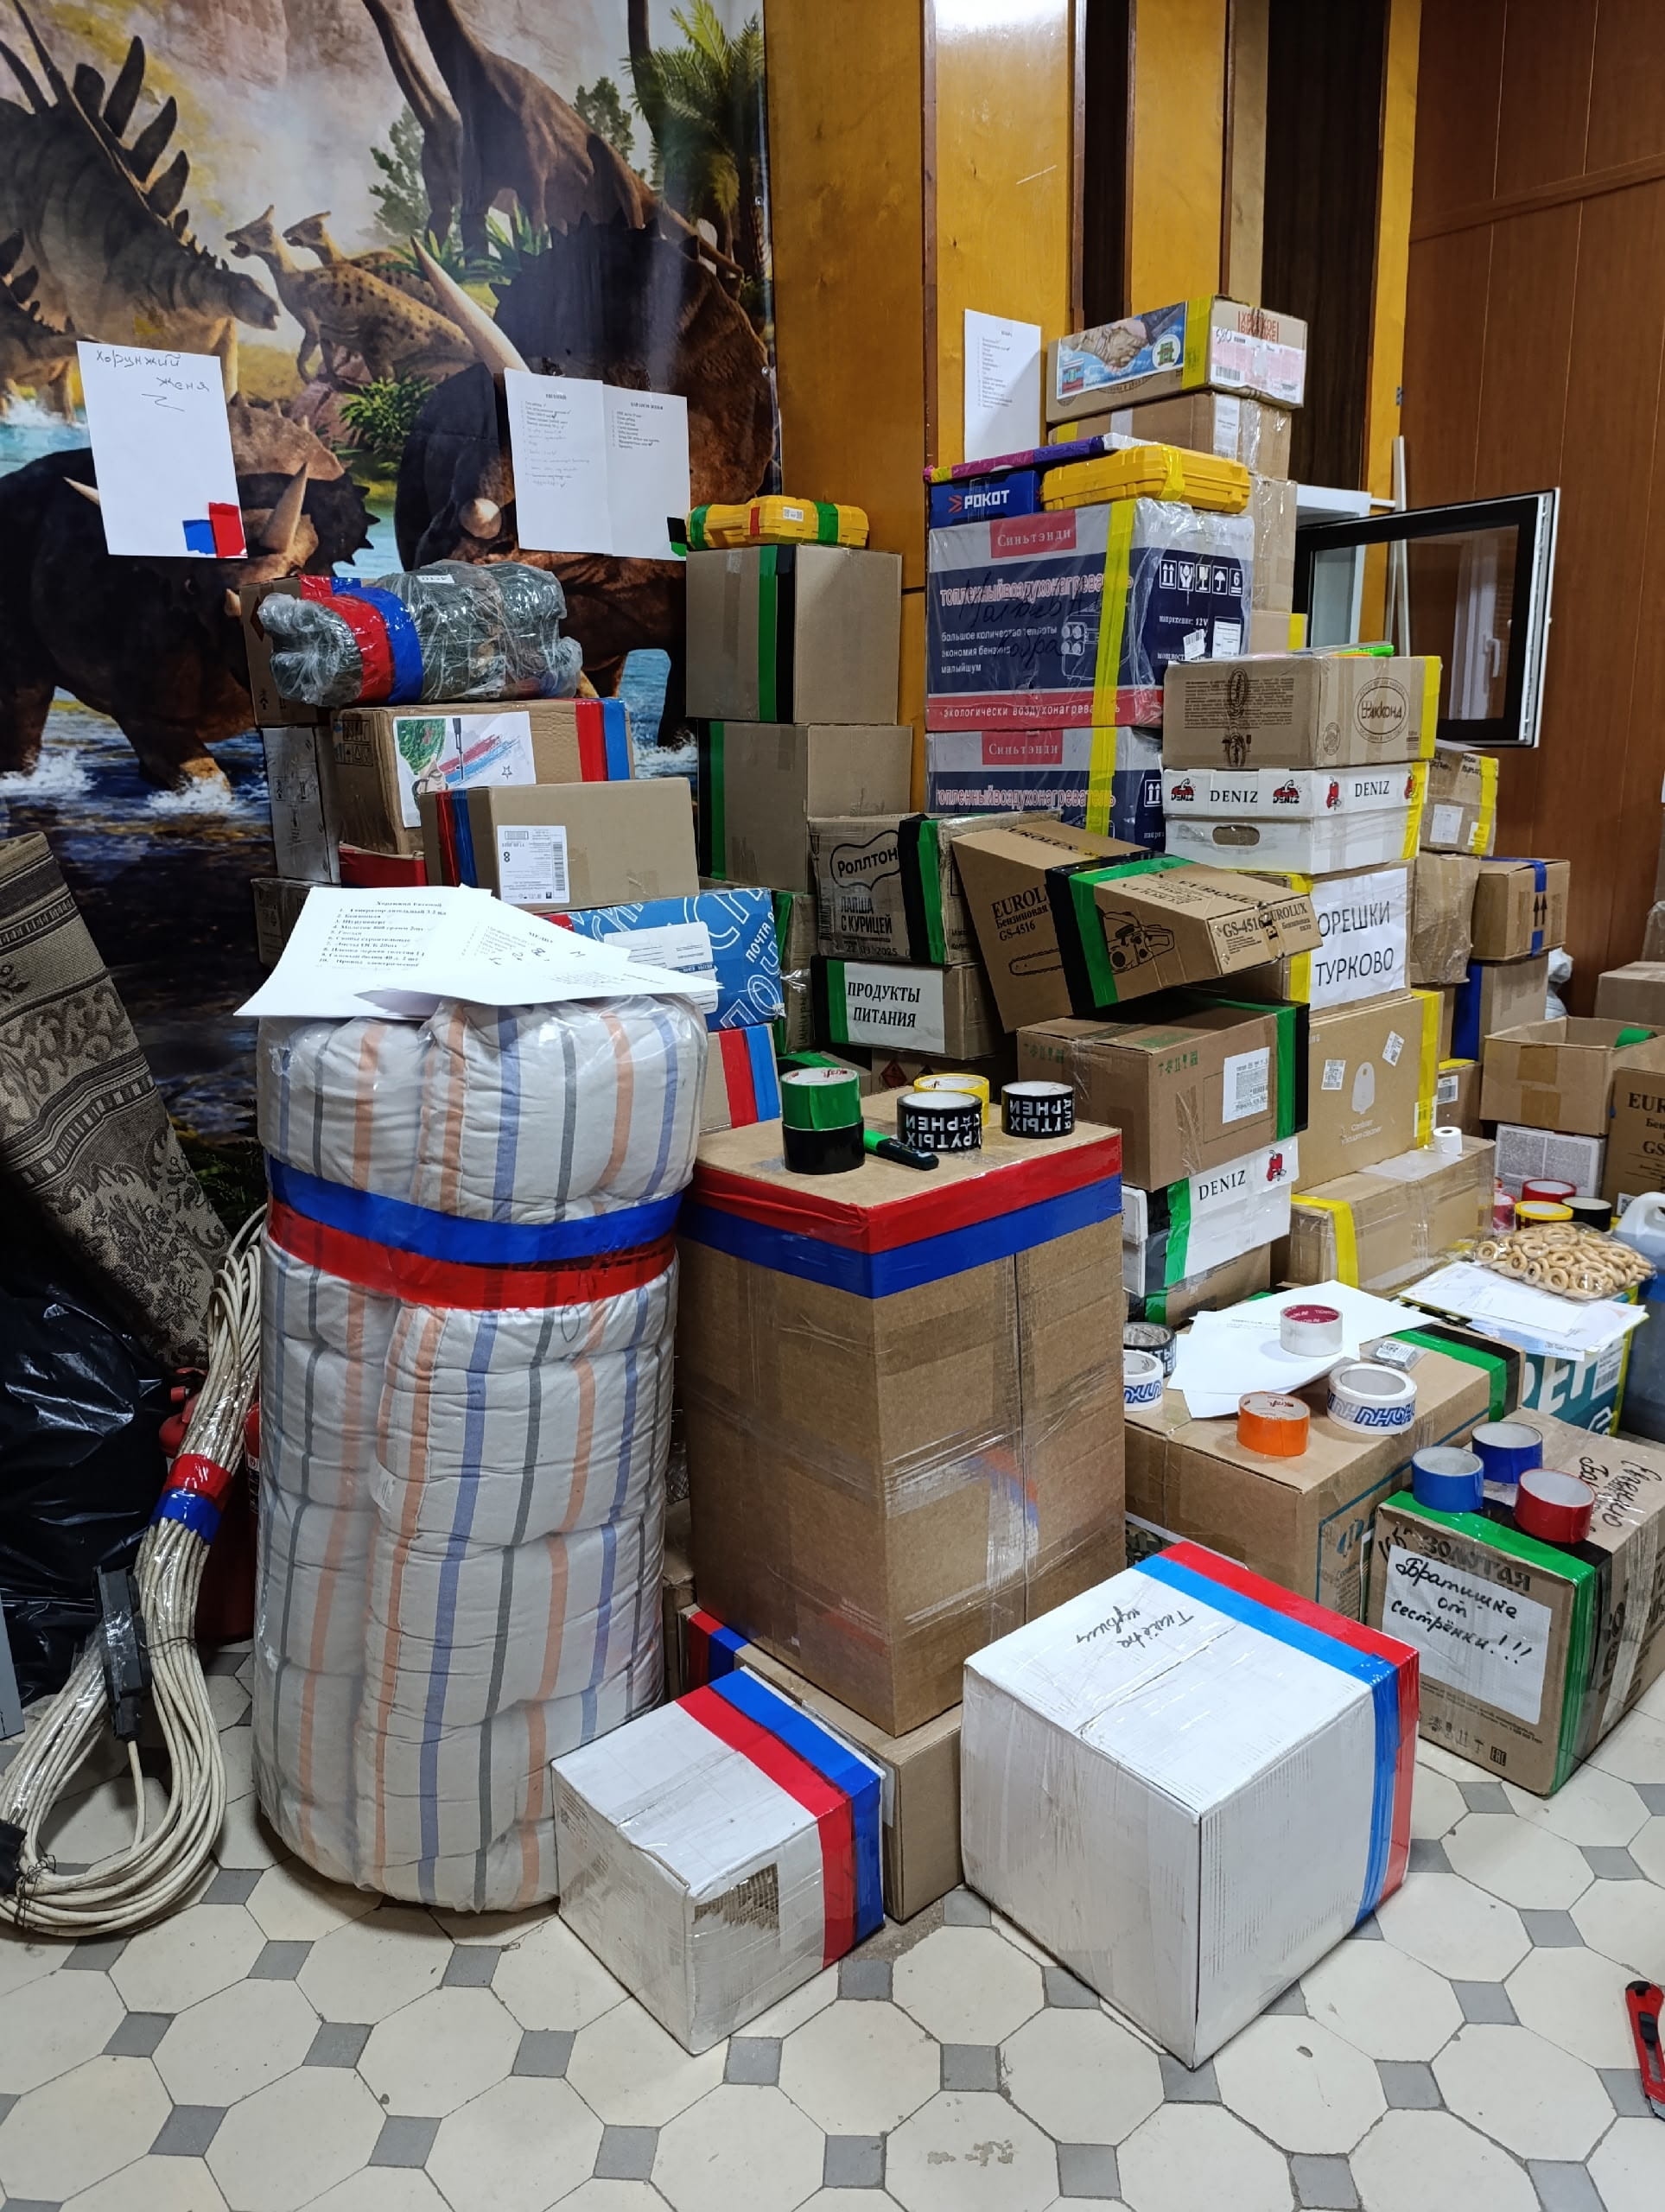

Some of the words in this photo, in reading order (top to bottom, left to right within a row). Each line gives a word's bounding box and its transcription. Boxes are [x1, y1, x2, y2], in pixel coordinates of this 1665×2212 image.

[964, 489, 1010, 510] РОКОТ
[997, 528, 1072, 548] Синьтэнди
[1195, 618, 1209, 626] 12V
[941, 630, 976, 643] большое
[943, 707, 1009, 718] экологически
[988, 742, 1059, 755] Синьтэнди
[1210, 791, 1259, 804] DENIZ
[1354, 779, 1390, 798] DENIZ
[842, 896, 874, 913] ЛАПША
[991, 884, 1051, 918] EUROL
[848, 914, 893, 935] КУРИЦЕЙ
[1223, 917, 1265, 938] GS-4516
[1318, 900, 1391, 938] ОРЕШКИ
[999, 920, 1037, 941] GS-4516
[746, 922, 772, 963] ПОЧТА
[1315, 947, 1395, 987] ТУРКОВО
[847, 982, 922, 1003] ПРОДУКТЫ
[853, 1007, 917, 1028] ПИТАНИЯ
[1198, 1170, 1246, 1202] DENIZ
[1395, 1557, 1518, 1619] Братишке
[1438, 1597, 1468, 1618] от
